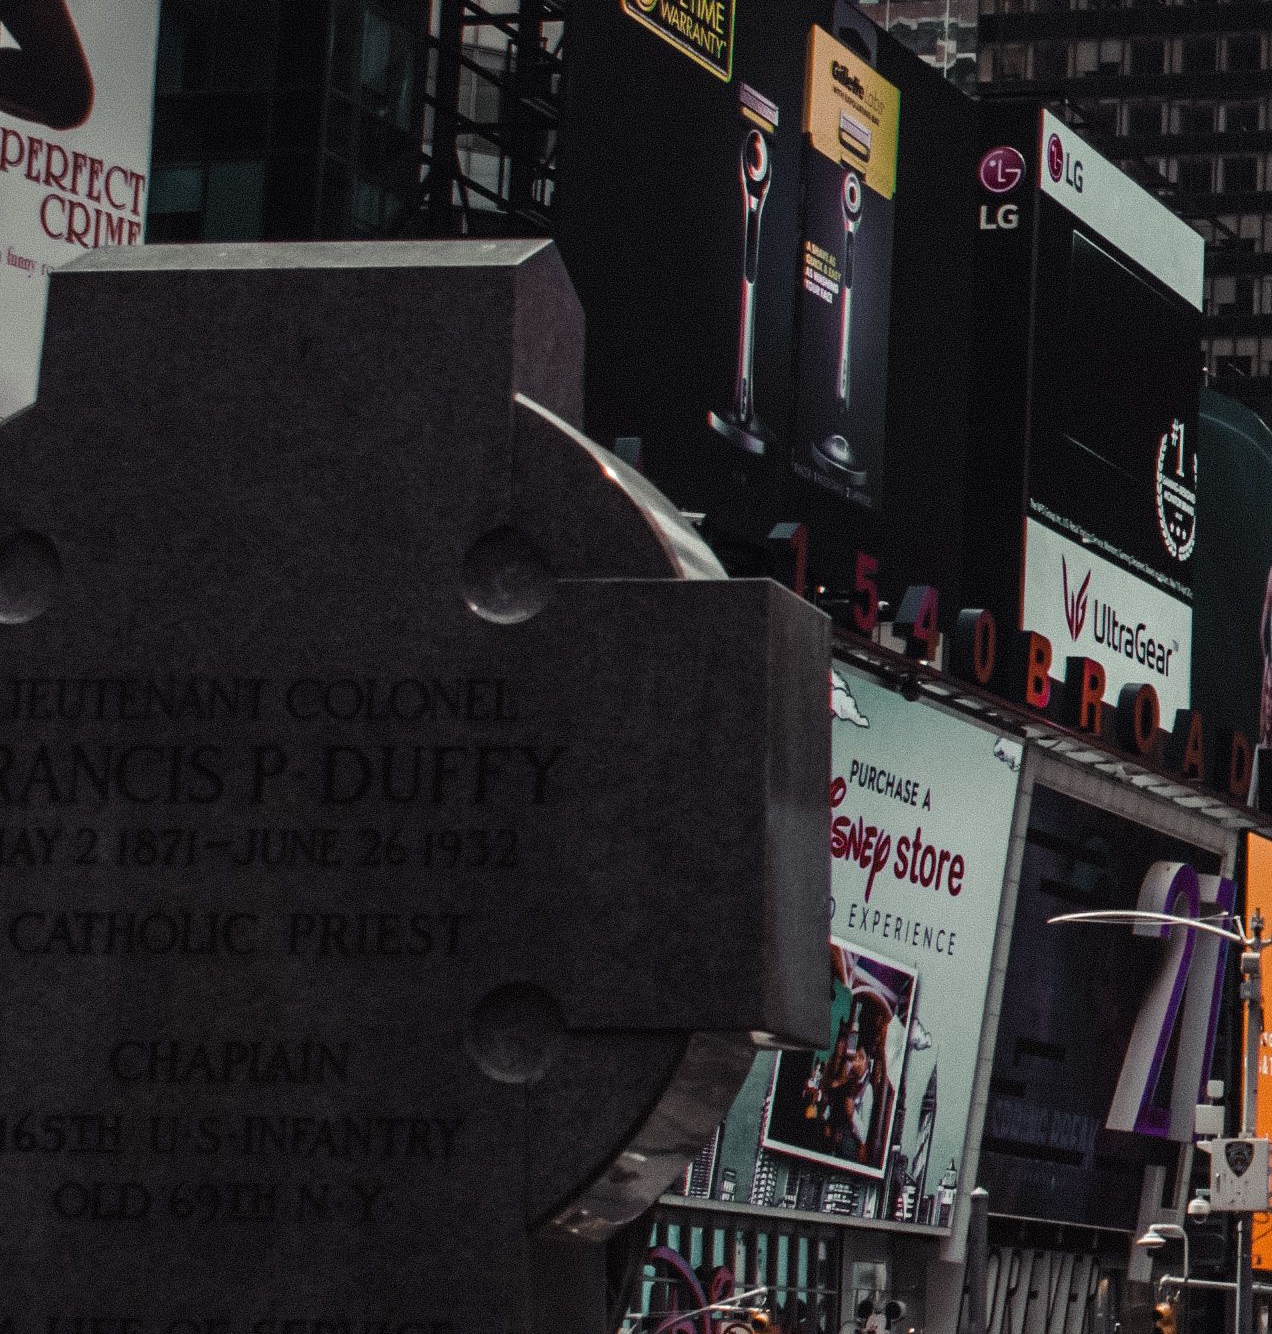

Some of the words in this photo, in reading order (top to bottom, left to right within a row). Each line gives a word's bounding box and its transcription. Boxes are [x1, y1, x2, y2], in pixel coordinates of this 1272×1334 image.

[832, 60, 865, 101] Gillette
[0, 127, 146, 217] PERFECT
[1066, 152, 1084, 194] LG
[981, 204, 1020, 230] LG
[1094, 600, 1173, 676] UltraGear
[285, 677, 519, 723] COLONEL
[319, 743, 571, 805] DUFFY
[850, 758, 920, 807] PURCHASE
[923, 787, 931, 812] A
[75, 827, 98, 867] 2
[358, 828, 407, 867] 26
[423, 829, 519, 869] 1932
[894, 827, 964, 897] store
[8, 913, 256, 957] CATHOLIC
[287, 913, 478, 957] PRIEST
[848, 903, 957, 956] EXPERIENCE
[107, 1040, 352, 1084] CHAPLAIN
[52, 1181, 152, 1221] OLD
[168, 1183, 277, 1222] 69TH
